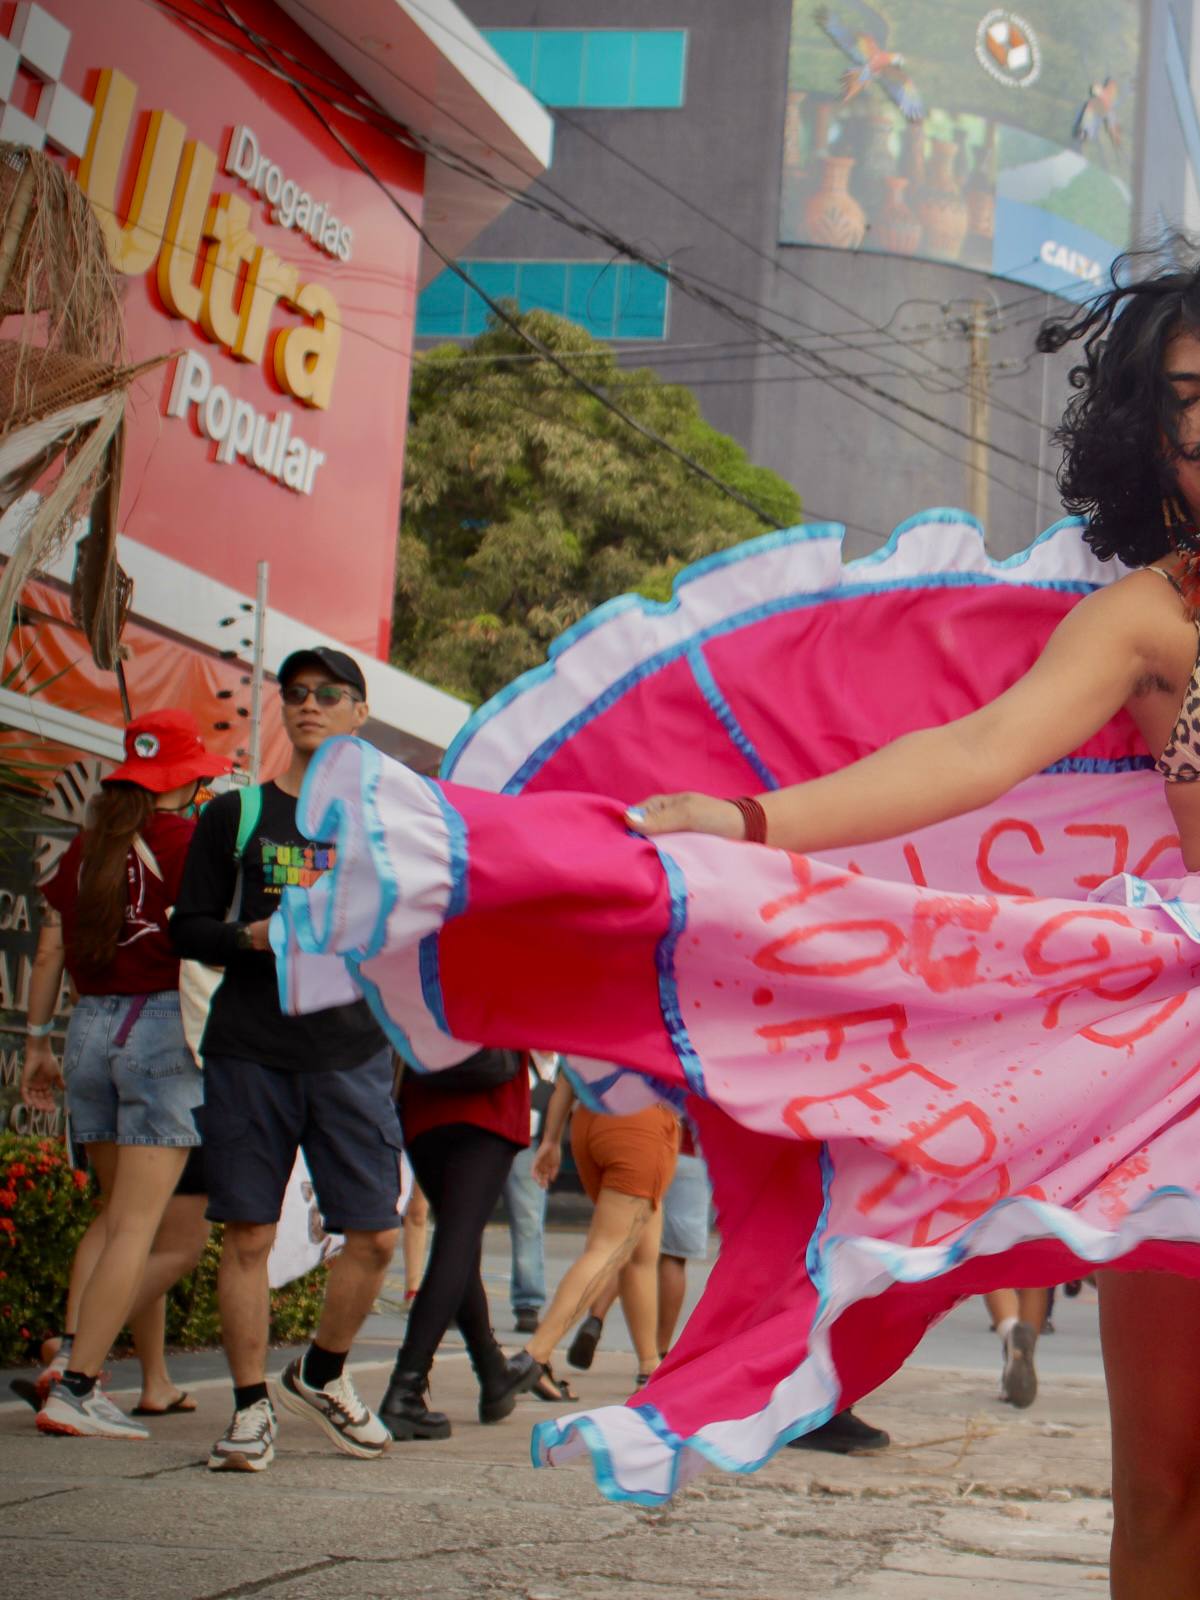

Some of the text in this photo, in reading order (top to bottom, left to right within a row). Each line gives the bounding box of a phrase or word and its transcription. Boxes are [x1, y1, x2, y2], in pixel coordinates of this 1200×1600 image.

[78, 67, 341, 411] Ultra
[227, 126, 353, 262] Drogarias
[1040, 240, 1103, 286] CAIXA
[168, 349, 327, 496] Popular
